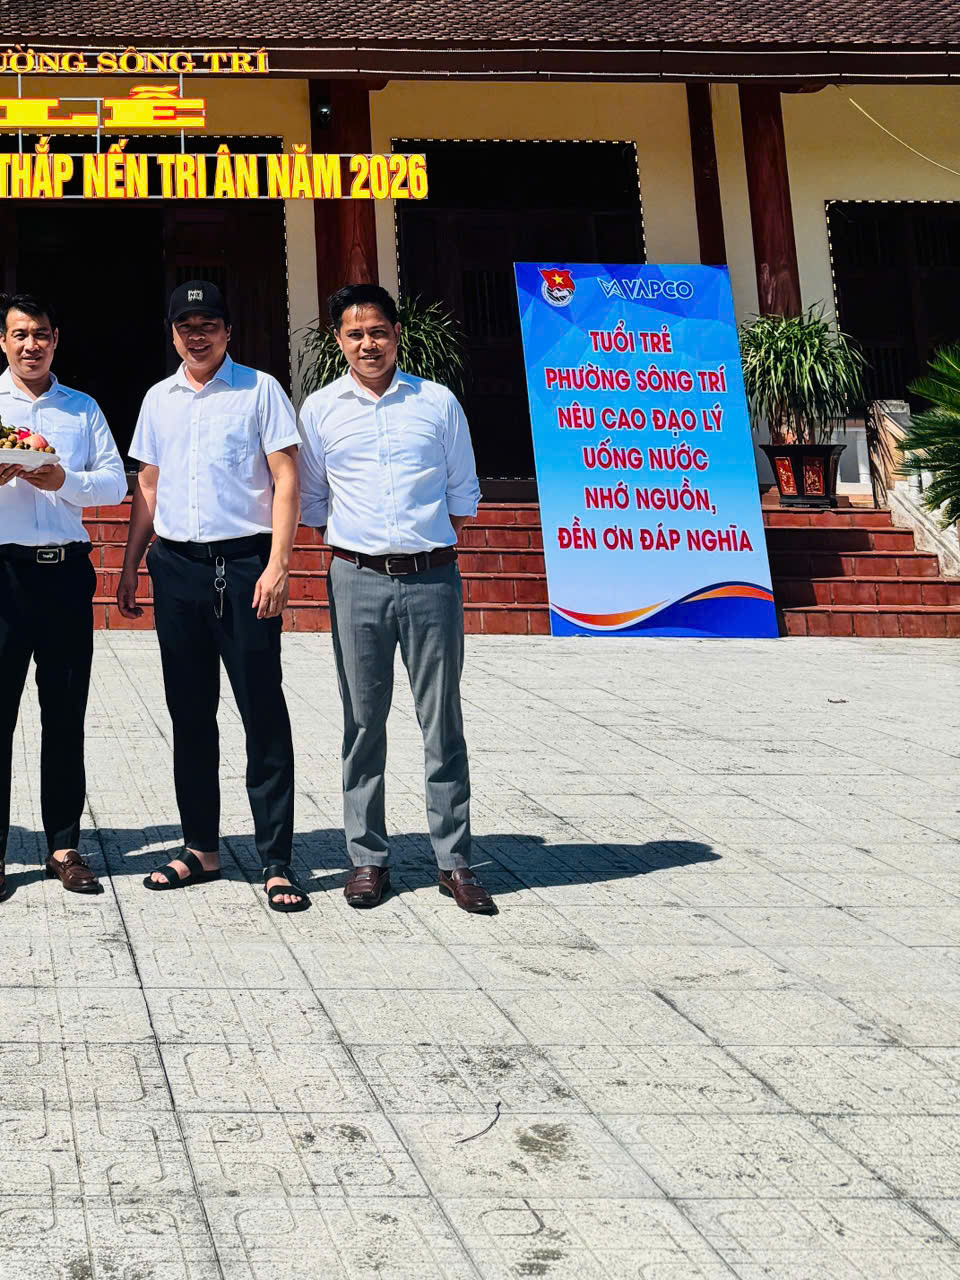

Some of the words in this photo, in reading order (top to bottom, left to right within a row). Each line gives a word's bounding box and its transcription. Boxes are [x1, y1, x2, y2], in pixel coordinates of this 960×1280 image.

[96, 46, 196, 74] SÔNG
[203, 47, 269, 74] TRÍ
[83, 138, 149, 199] NẾN
[157, 153, 207, 199] TRI
[213, 143, 259, 199] ÂN
[267, 143, 342, 199] NĂM
[349, 153, 429, 200] 2026
[622, 277, 695, 301] VAPCO
[589, 319, 636, 353] TUỔI
[640, 324, 673, 354] TRẺ
[544, 362, 631, 391] PHƯỜNG
[636, 364, 693, 392] SÔNG
[698, 365, 728, 393] TRÍ
[557, 401, 596, 430] NÊU
[601, 407, 646, 431] CAO
[651, 409, 697, 438] ĐẠO
[701, 403, 725, 431] LÝ
[582, 438, 644, 470] UỐNG
[648, 442, 709, 471] NƯỚC
[585, 481, 630, 510] NHỚ
[635, 477, 717, 515] NGUỒN,
[557, 516, 598, 550] ĐỀN
[603, 524, 634, 551] ƠN
[639, 522, 681, 551] ĐÁP
[686, 524, 754, 552] NGHĨA
